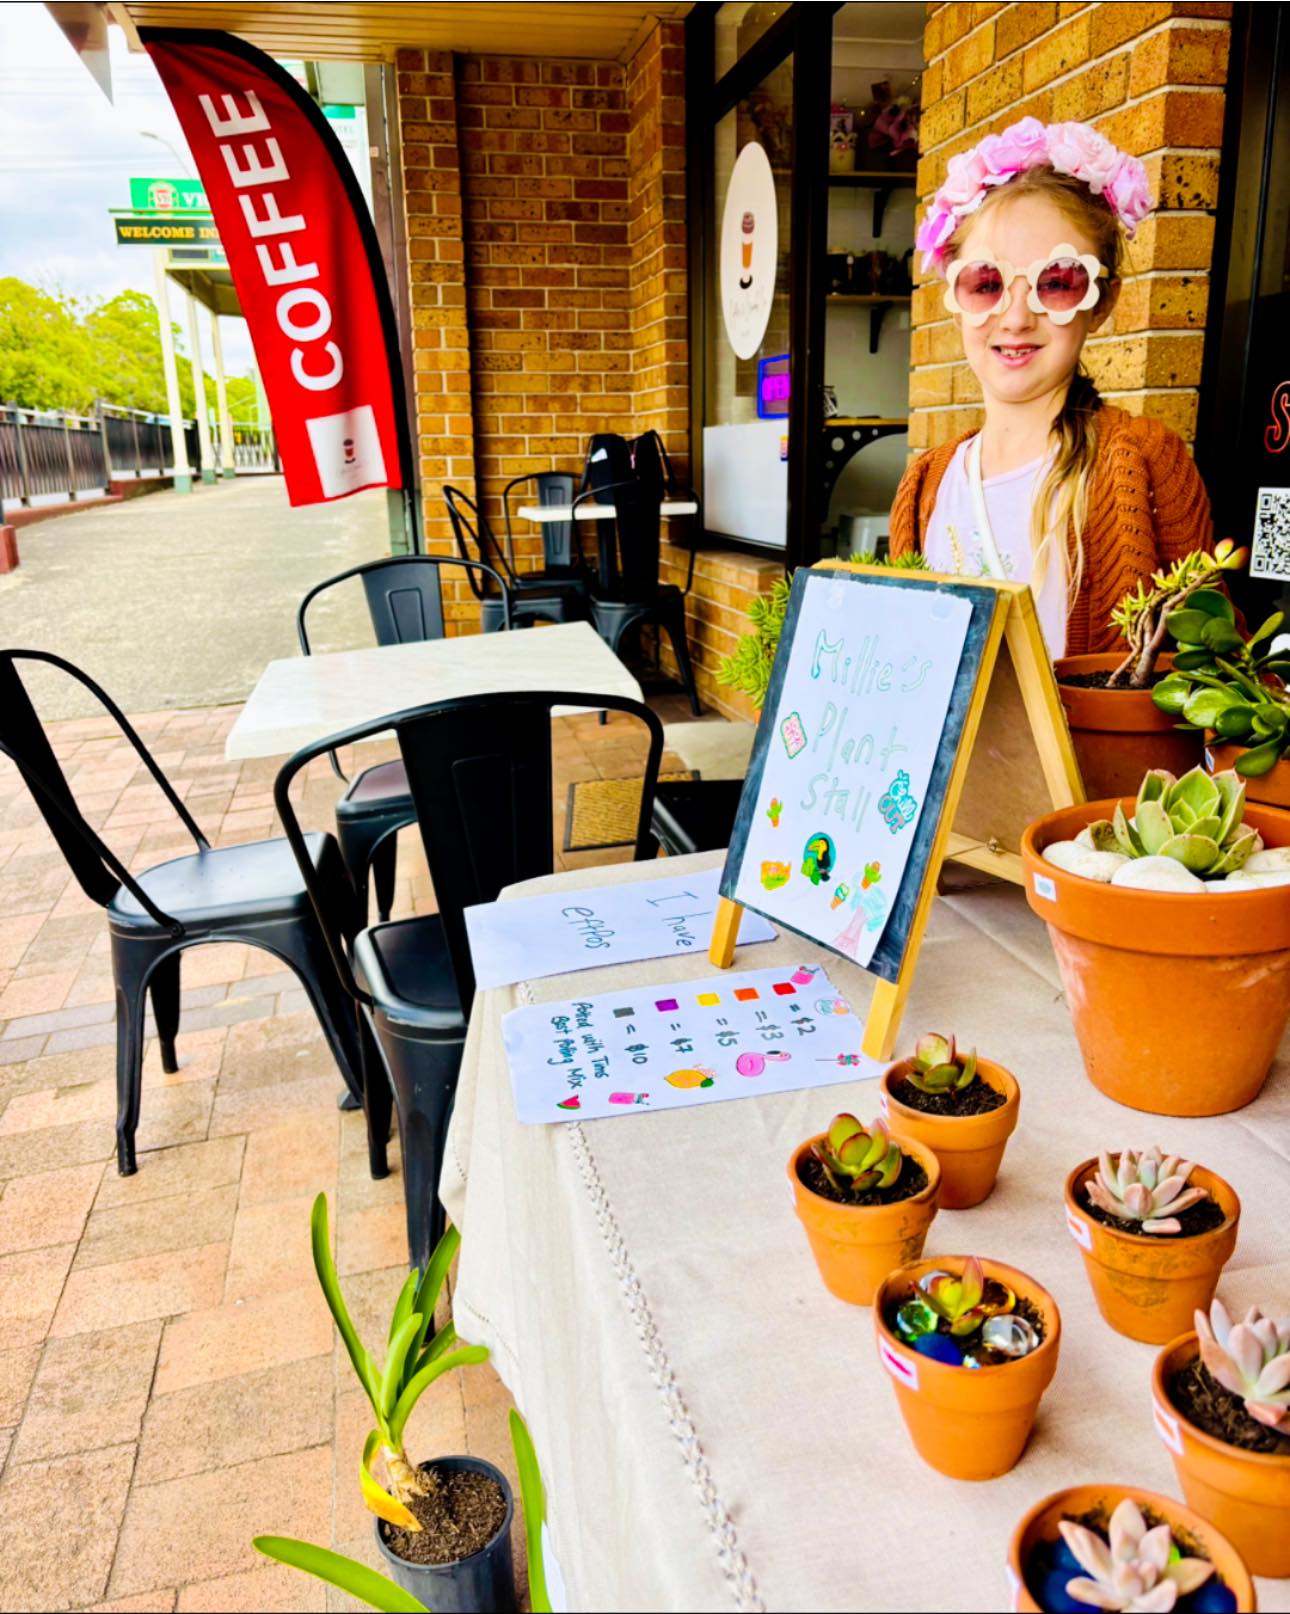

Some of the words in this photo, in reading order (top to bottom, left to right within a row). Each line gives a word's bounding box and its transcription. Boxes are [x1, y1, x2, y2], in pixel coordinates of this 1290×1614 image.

[119, 226, 195, 239] WELCOME
[199, 90, 344, 391] COFFEE
[811, 629, 932, 696] Millie's
[812, 702, 908, 772] Plant
[800, 773, 872, 833] Stall
[645, 891, 699, 907] I
[661, 911, 712, 947] have
[755, 1023, 785, 1041] $3
[789, 1016, 816, 1036] $2
[581, 1034, 604, 1054] with
[669, 1038, 694, 1053] $7
[714, 1030, 740, 1047] $5
[551, 1015, 573, 1035] Best
[567, 1067, 587, 1090] Mix
[623, 1043, 650, 1065] $10
